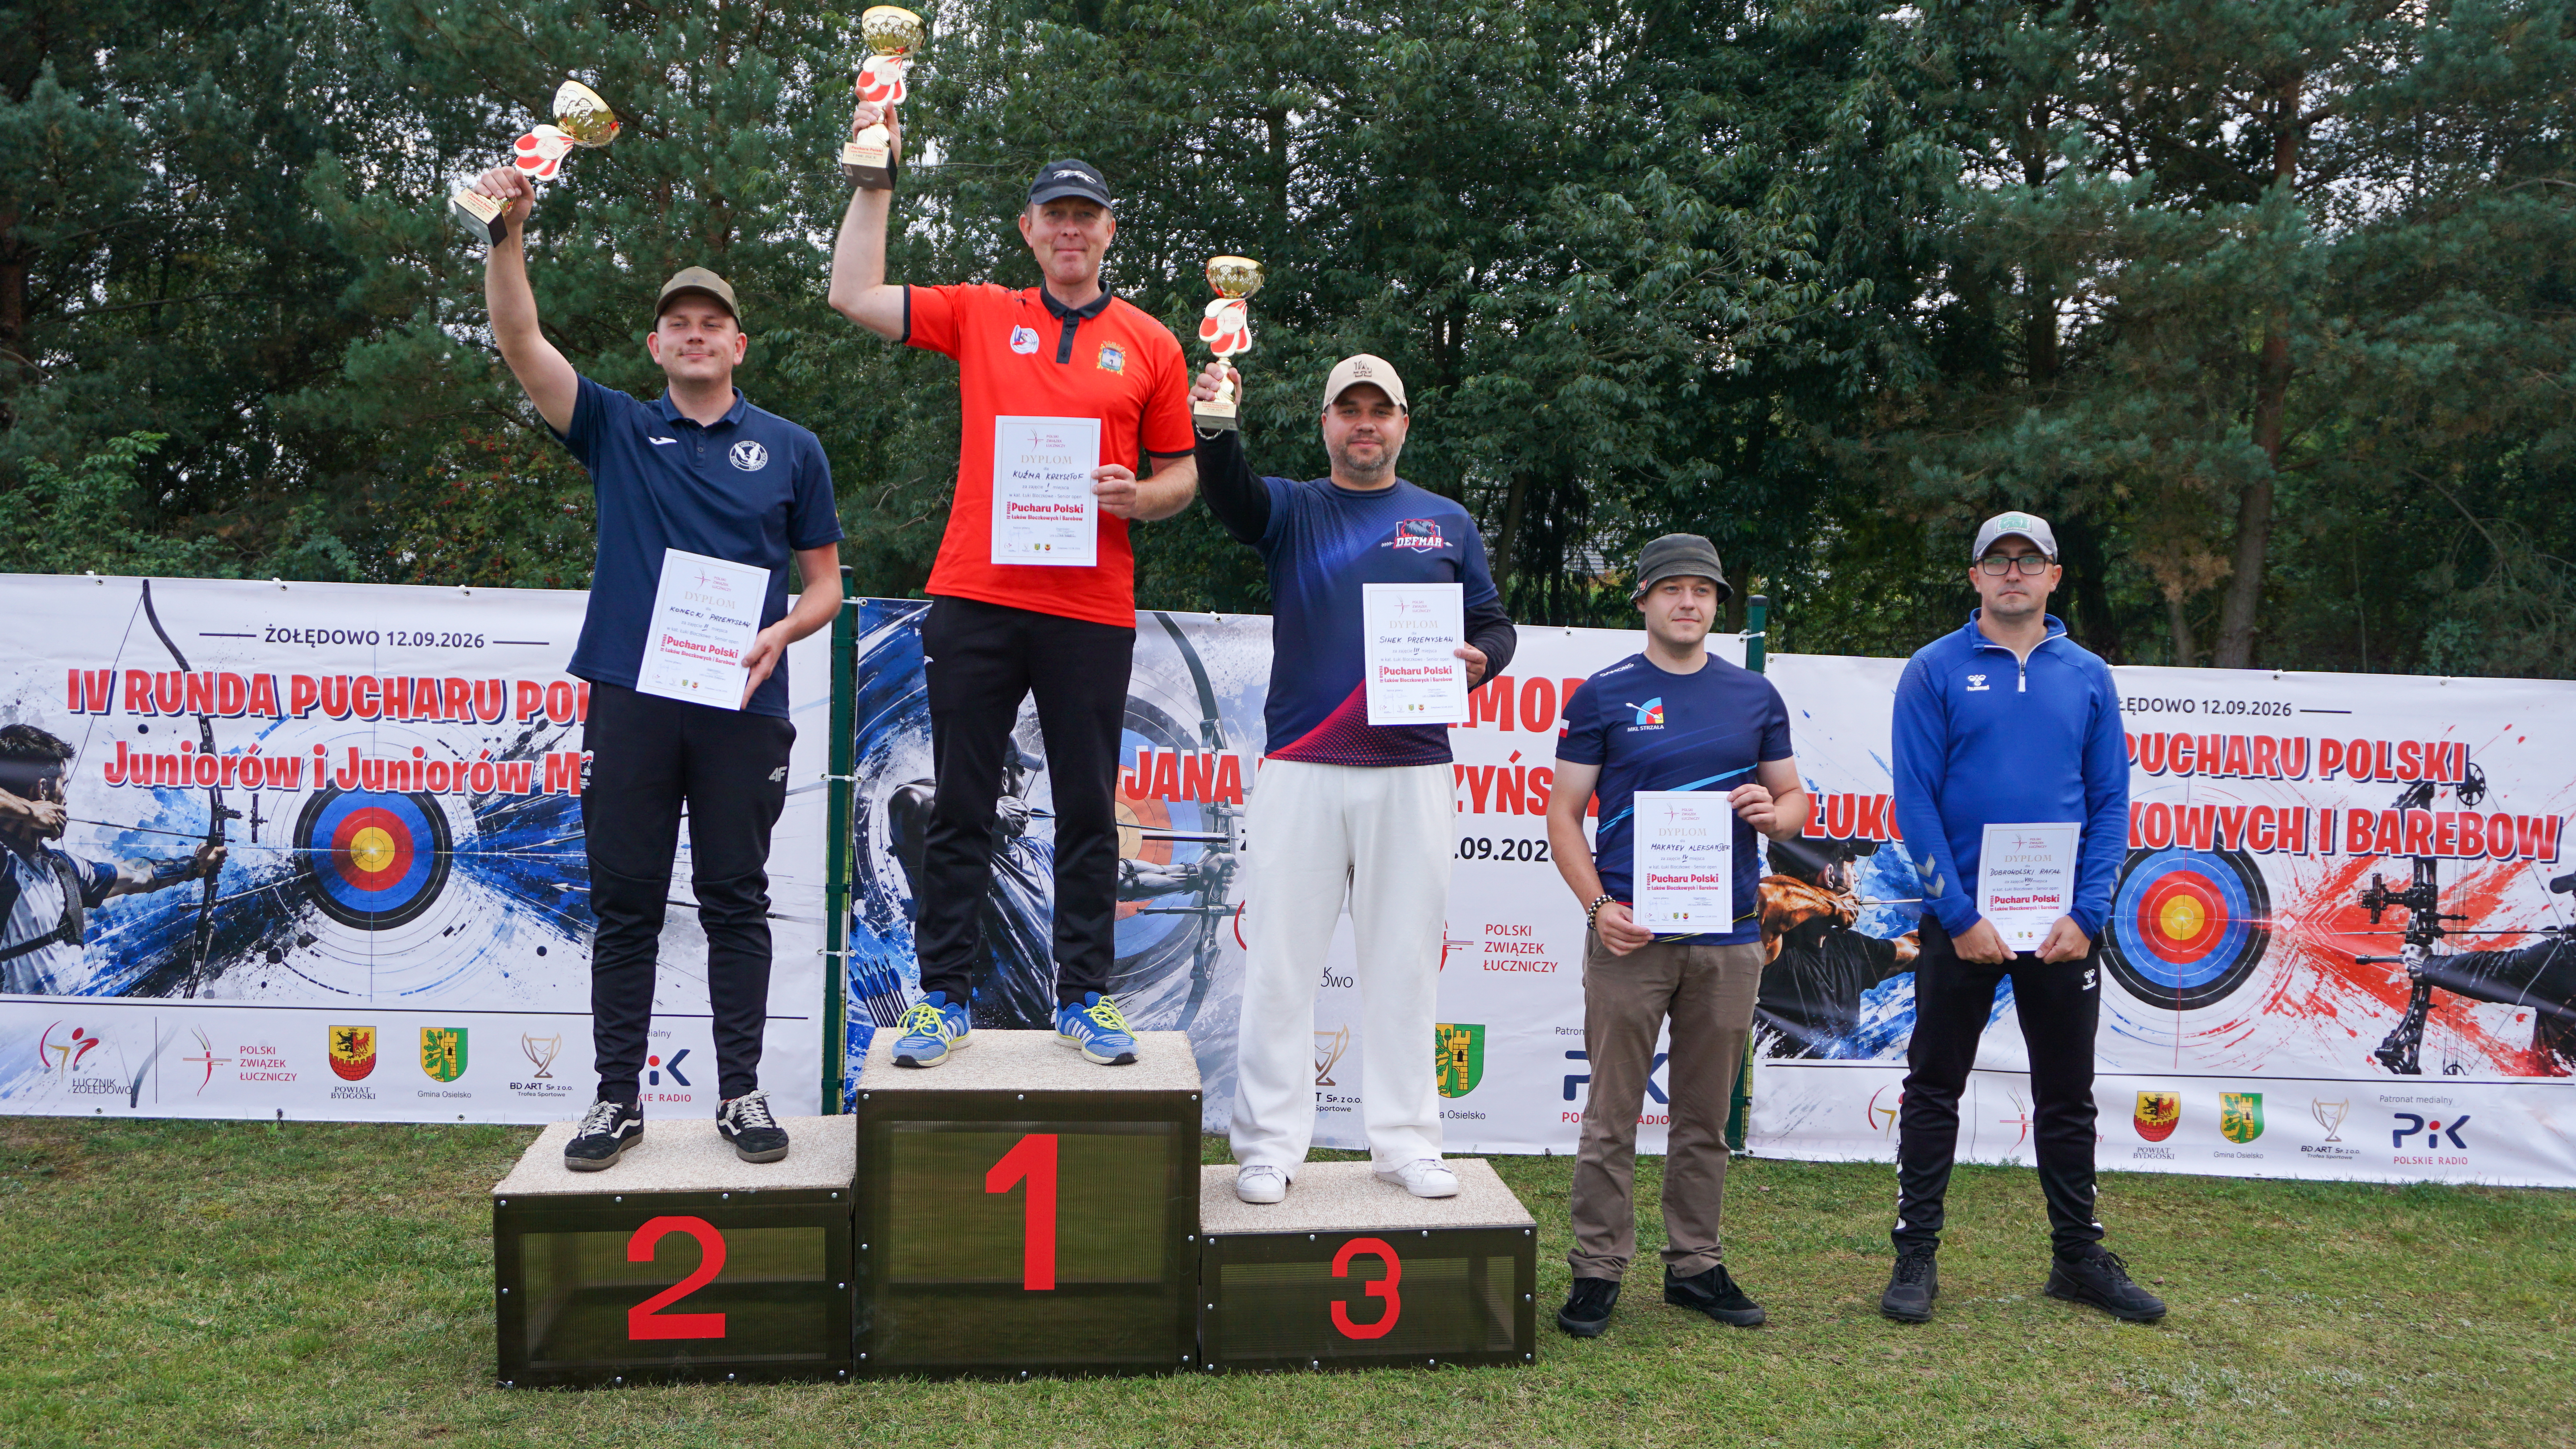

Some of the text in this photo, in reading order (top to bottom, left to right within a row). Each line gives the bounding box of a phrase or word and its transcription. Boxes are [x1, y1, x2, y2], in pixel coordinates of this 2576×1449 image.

[1021, 455, 1072, 464] DYPLOM
[1011, 503, 1083, 513] Pucharu Polski
[1396, 537, 1442, 547] DEFMAR
[685, 591, 735, 609] DYPLOM
[670, 606, 703, 618] KONECKI
[1389, 620, 1438, 629] DYPLOM
[265, 624, 485, 648] ŻOŁĘDOWO 12.09.2026
[667, 636, 739, 658] Pucharu Polski
[1384, 665, 1452, 675] Pucharu Polski
[1600, 663, 1634, 676] DAMONS
[68, 668, 116, 715] IV
[125, 668, 280, 718] RUNDA
[291, 673, 505, 722] PUCHARU
[2118, 697, 2292, 716] ŁĘDOWO 12.09.2026
[2319, 738, 2467, 783] POLSKI
[105, 740, 303, 790] Juniorów
[314, 743, 327, 790] i
[337, 746, 535, 794] Juniorów
[769, 766, 787, 782] 4F
[1123, 750, 1244, 805] JANA
[1659, 828, 1707, 836] DYPLOM
[2126, 802, 2306, 853] KOWYCH
[2346, 807, 2560, 861] BAREBOW
[1651, 873, 1719, 883] Pucharu Polski
[2033, 894, 2060, 903] Polski
[1485, 924, 1532, 936] POLSKI
[1484, 942, 1545, 956] ZWIĄZEK
[1483, 960, 1558, 972] ŁUCZNICZY
[240, 1046, 275, 1054] POLSKI
[240, 1059, 286, 1069] ZWIĄZEK
[73, 1078, 116, 1087] ŁUCZNIK
[240, 1072, 297, 1081] ŁUCZNICZY
[659, 1094, 691, 1102] RADIO
[2380, 1095, 2453, 1105] Patronat medialny
[1448, 1110, 1486, 1120] Osielsko
[1637, 1115, 1670, 1125] ADIO
[2394, 1156, 2468, 1165] POLSKIE RADIO
[985, 1133, 1057, 1291] 1
[627, 1216, 727, 1340] 2
[1330, 1238, 1401, 1339] 3
